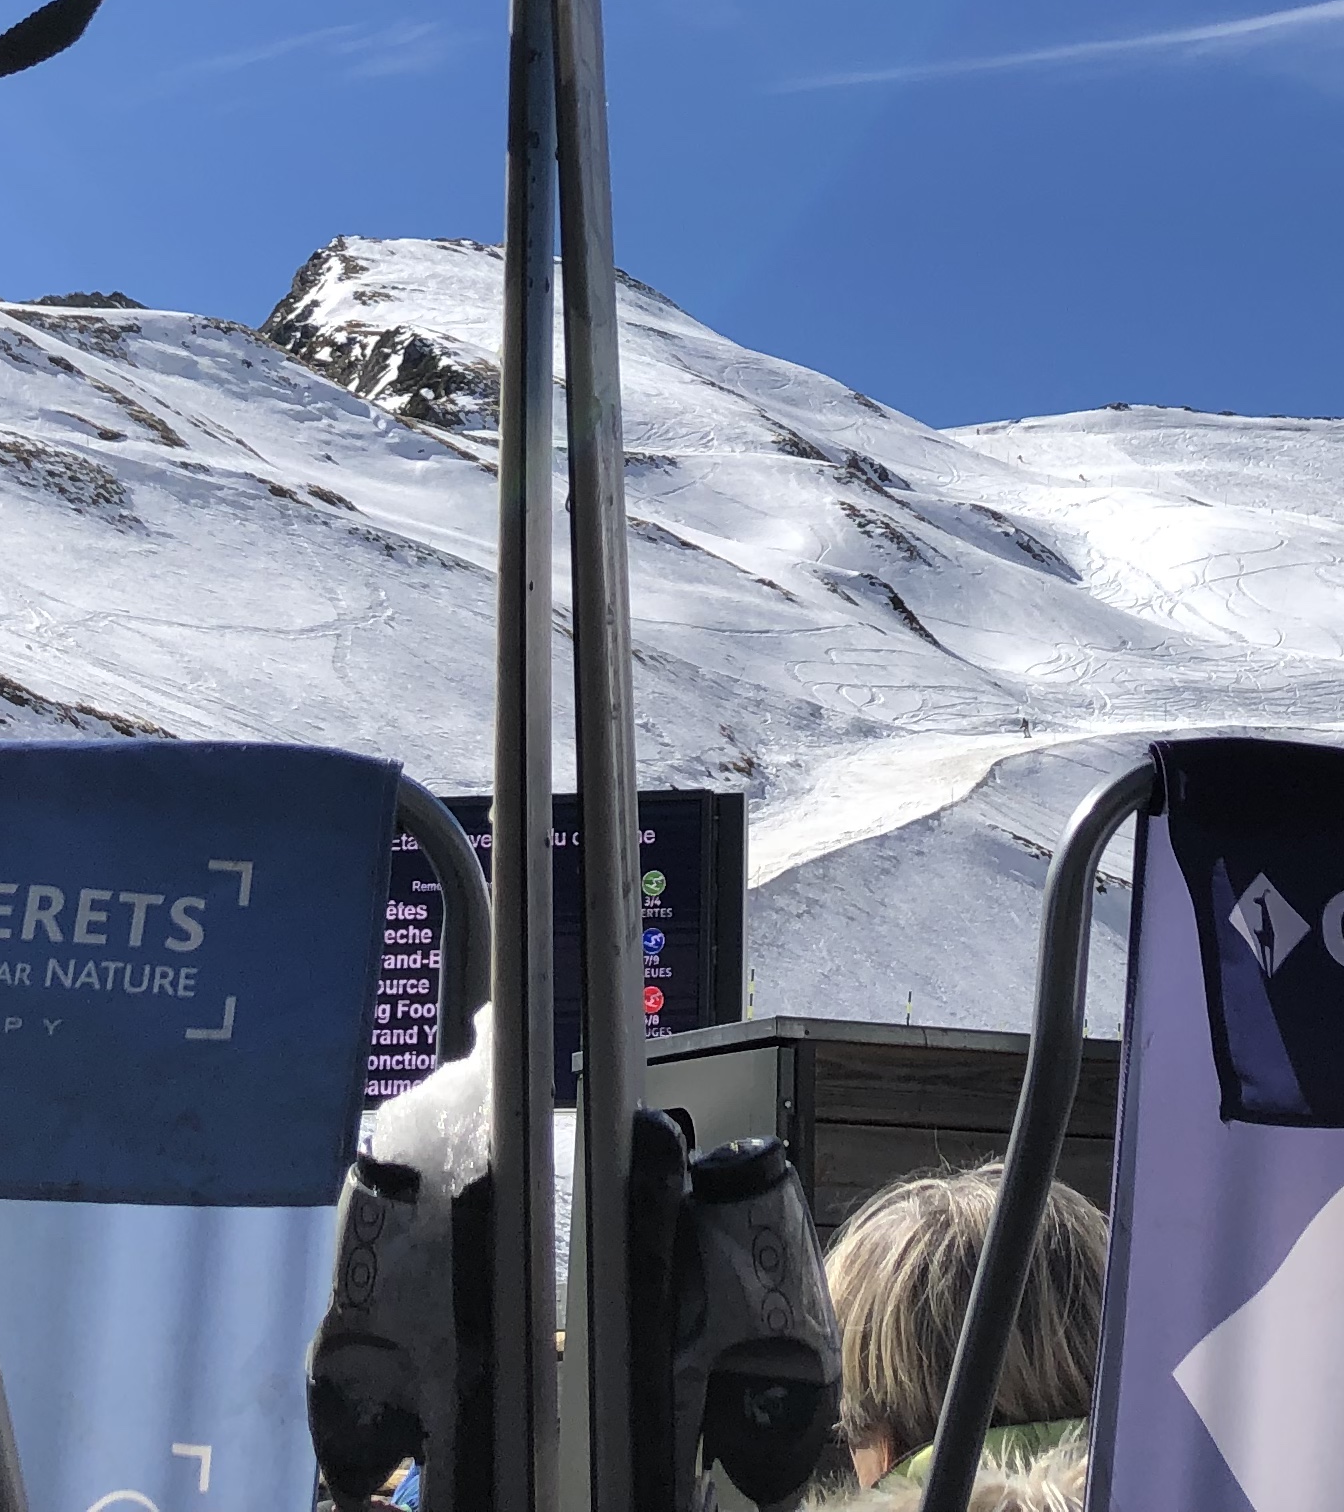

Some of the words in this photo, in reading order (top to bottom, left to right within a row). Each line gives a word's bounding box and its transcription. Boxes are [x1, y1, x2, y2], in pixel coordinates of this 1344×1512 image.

[386, 899, 428, 921] êtes
[641, 908, 673, 918] ERTES
[384, 925, 433, 945] eche
[44, 958, 200, 998] NATURE
[644, 968, 673, 978] EUES
[397, 1000, 437, 1019] Foo
[371, 1025, 418, 1045] rand
